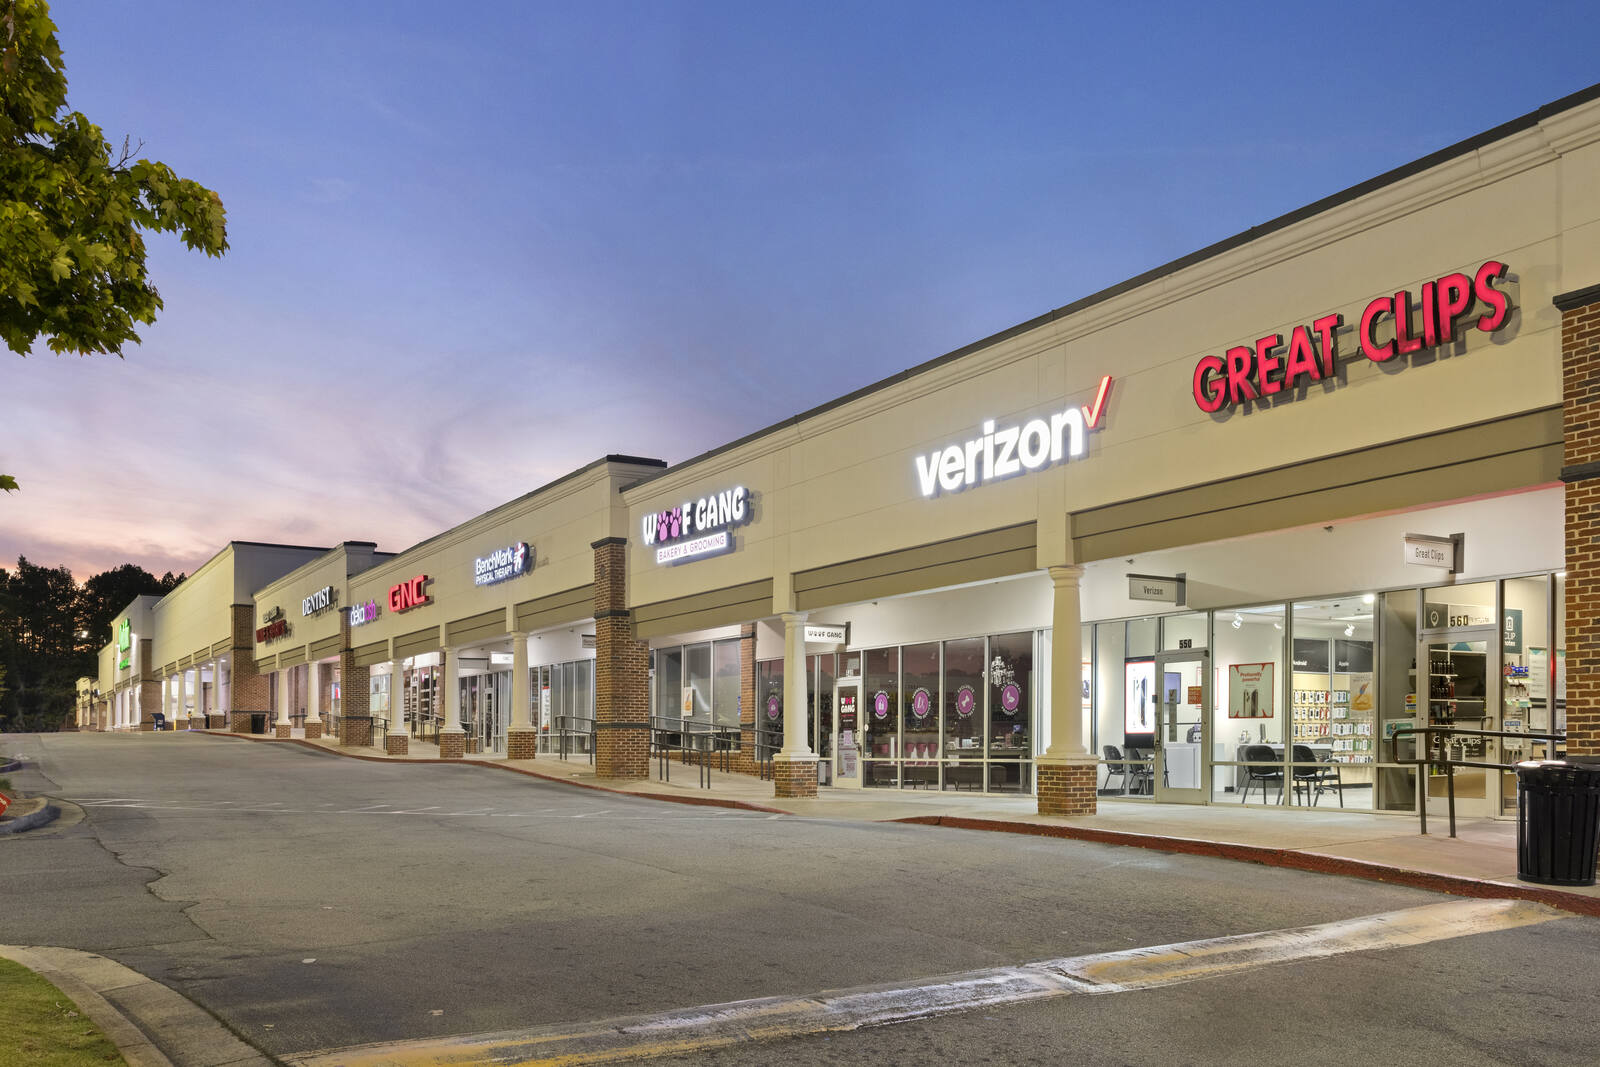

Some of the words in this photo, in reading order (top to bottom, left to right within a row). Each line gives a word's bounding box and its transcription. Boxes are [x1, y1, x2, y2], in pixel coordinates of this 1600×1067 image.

[1193, 313, 1342, 413] GREAT
[1360, 261, 1508, 362] CLIPS
[915, 408, 1084, 496] verizon
[695, 486, 745, 531] GANG
[659, 547, 682, 561] BAKERY
[683, 545, 688, 555] &
[689, 535, 725, 553] GROOMING
[1415, 547, 1430, 559] Great
[1430, 549, 1445, 562] Clips
[388, 574, 426, 612] GNC
[1143, 585, 1164, 596] Verizon
[302, 586, 331, 616] DENTIST
[1450, 615, 1469, 627] 560
[1179, 639, 1192, 648] 550
[841, 705, 855, 713] GANG
[1460, 736, 1481, 746] Clips
